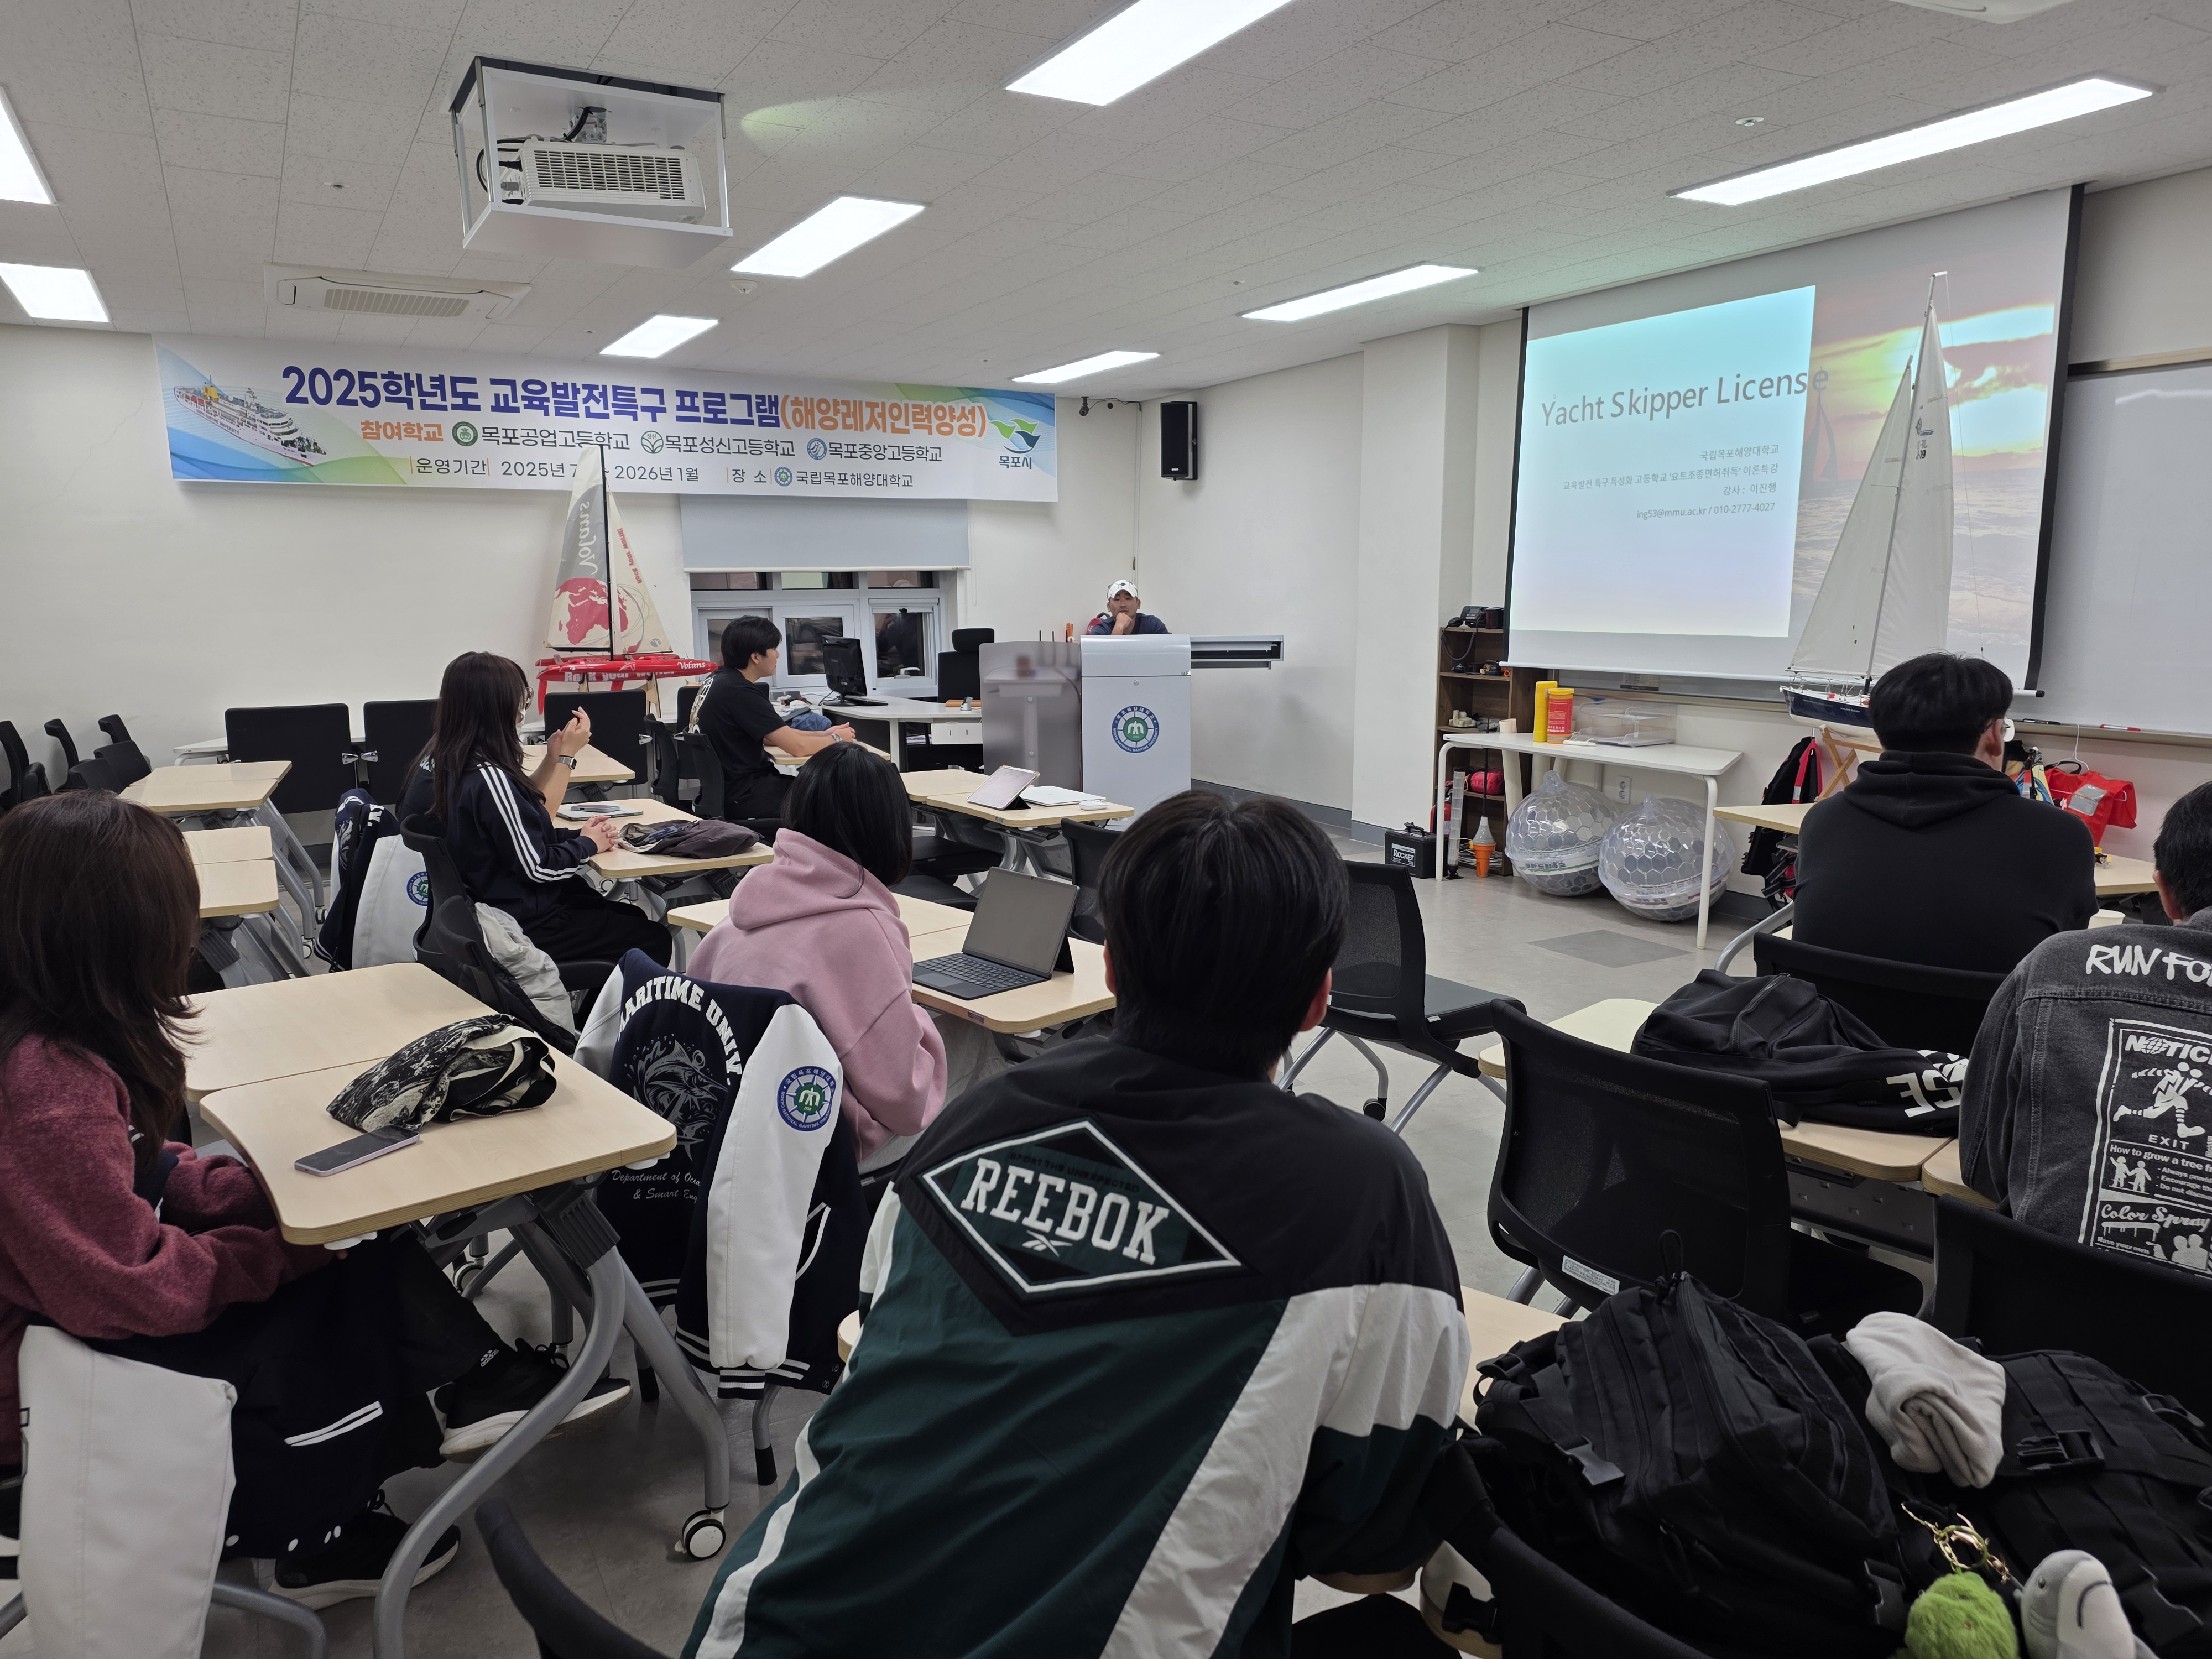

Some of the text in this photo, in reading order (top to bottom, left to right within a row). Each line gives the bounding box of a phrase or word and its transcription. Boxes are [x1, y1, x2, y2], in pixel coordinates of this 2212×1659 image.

[282, 366, 988, 439] 2025학년도 교육발전특구 프로그램(해양레저인력양성)
[1541, 369, 1829, 426] Yacht Skipper License
[219, 421, 239, 435] UNIVERSITY
[361, 420, 444, 442] 참여학교
[482, 426, 630, 450] 목포공업고등학교
[665, 435, 795, 457] 목포성신고등학교
[828, 441, 942, 463] 목포중앙고등학교
[1700, 444, 1780, 461] 국립목포해양대학교
[416, 458, 487, 476] 운영기간
[501, 461, 565, 478] 2025년
[570, 463, 578, 478] 7
[615, 466, 672, 481] 2026년
[680, 468, 699, 482] 1월
[999, 455, 1033, 470] 목포시
[732, 469, 743, 483] 장
[754, 471, 767, 483] 소
[796, 471, 914, 487] 국립목포해양대학교
[1563, 479, 1593, 490] 교육발전
[1595, 478, 1609, 488] 특구
[1610, 475, 1633, 486] 특성화
[1635, 473, 1667, 484] 고등학교
[1743, 463, 1778, 476] 이론특강
[1723, 486, 1740, 496] 강사
[1750, 482, 1776, 494] 이진행
[1637, 507, 1707, 520] ing53@mmu.ac.kr
[1714, 503, 1775, 514] 010-2777-4027
[565, 671, 596, 681] Rok
[1117, 740, 1132, 752] NATIONAL
[1148, 728, 1159, 746] UNIVERSITY
[1393, 849, 1414, 861] ROCKET
[2085, 945, 2212, 987] RUN FO
[706, 999, 742, 1086] UNIV.
[2125, 1035, 2212, 1065] NOTIC
[782, 1109, 798, 1126] NATIONAL
[2148, 1134, 2189, 1150] EXIT
[2110, 1144, 2131, 1155] How
[2132, 1148, 2142, 1156] to
[2143, 1152, 2170, 1162] grow
[2181, 1159, 2203, 1170] tree
[612, 1170, 700, 1187] Department of Ocea
[2162, 1167, 2188, 1177] Always
[2161, 1175, 2201, 1189] Encourage
[633, 1188, 698, 1204] & Smart Eng
[960, 1158, 1170, 1265] REEBOK
[2101, 1204, 2211, 1233] Color Spray
[2098, 1236, 2150, 1255] Have your own
